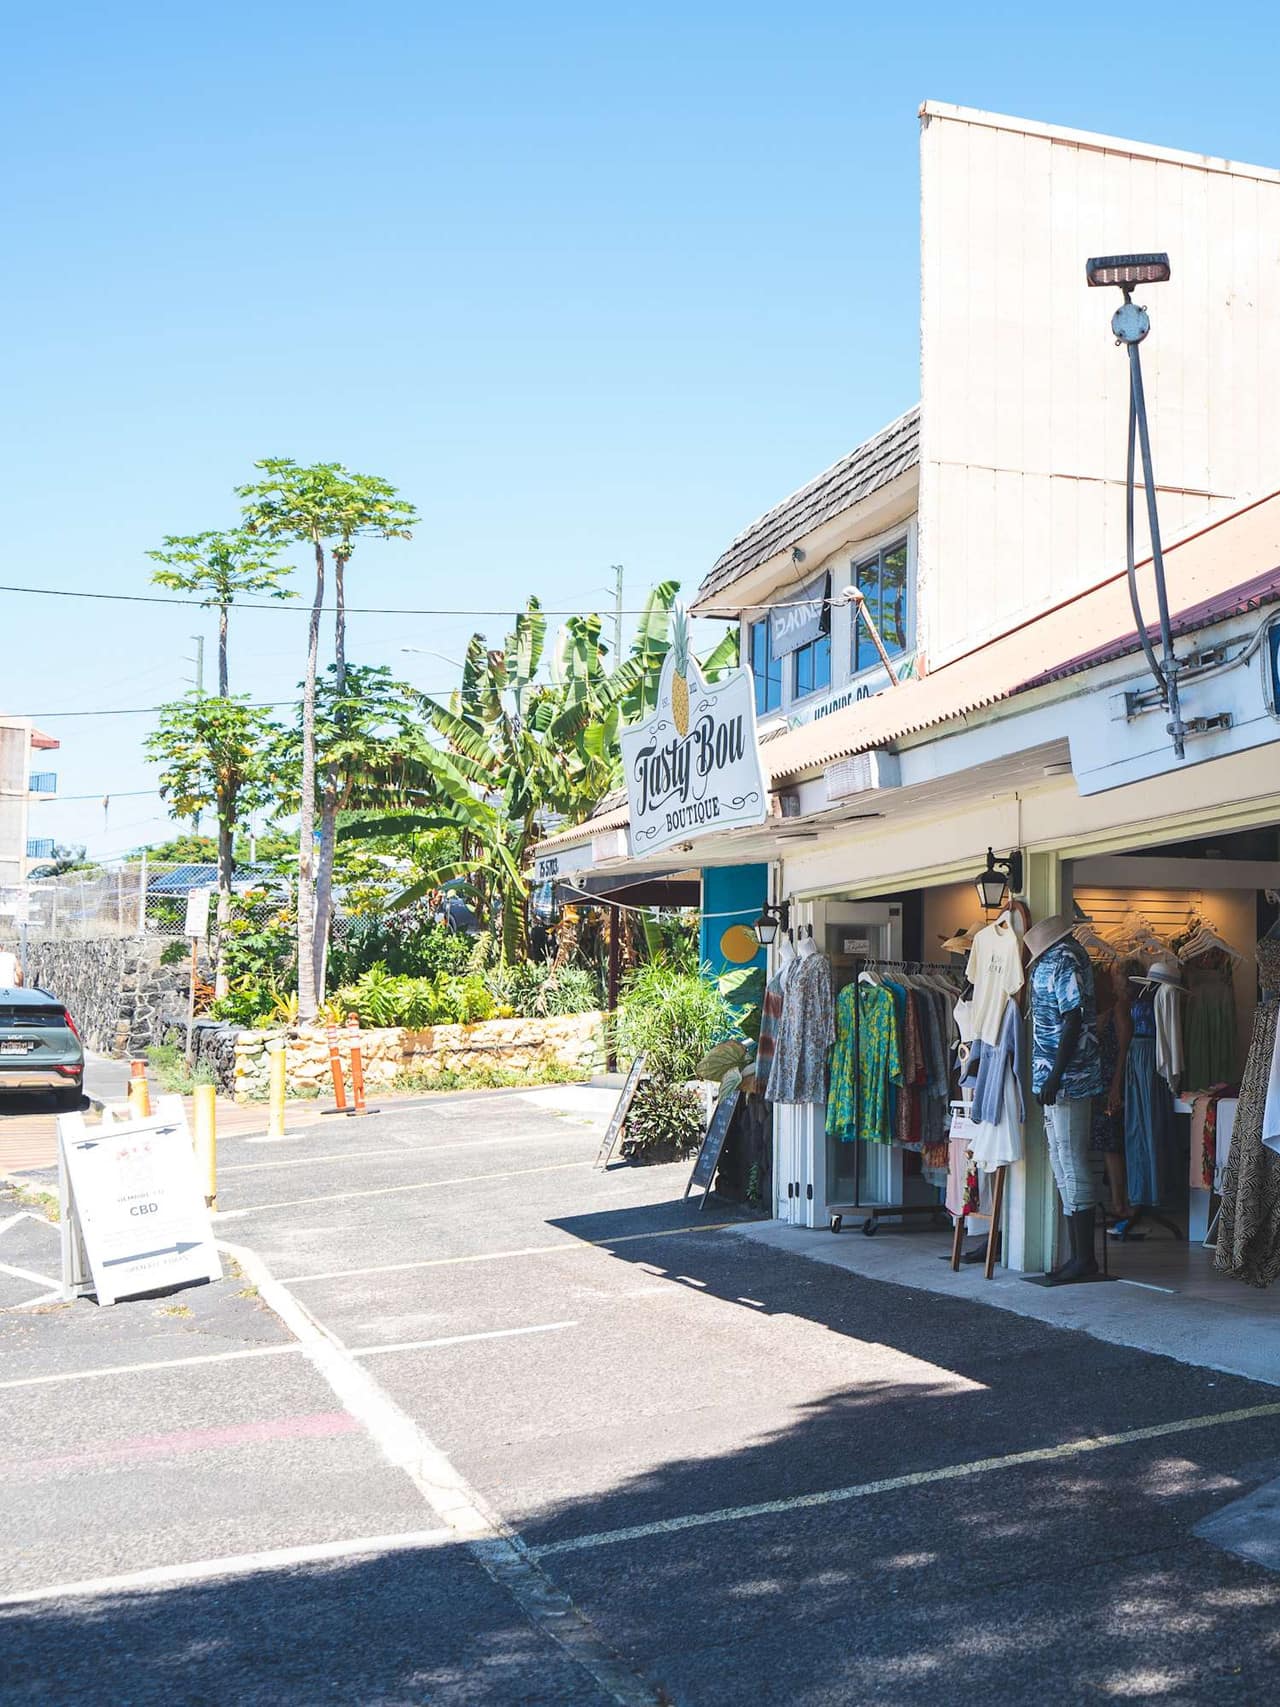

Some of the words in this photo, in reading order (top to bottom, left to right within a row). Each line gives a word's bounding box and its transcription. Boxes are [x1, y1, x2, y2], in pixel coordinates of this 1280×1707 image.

[634, 731, 702, 817] Tasty
[692, 715, 745, 800] Bou
[665, 796, 721, 833] BOUTIQUE
[129, 1202, 160, 1217] CBD
